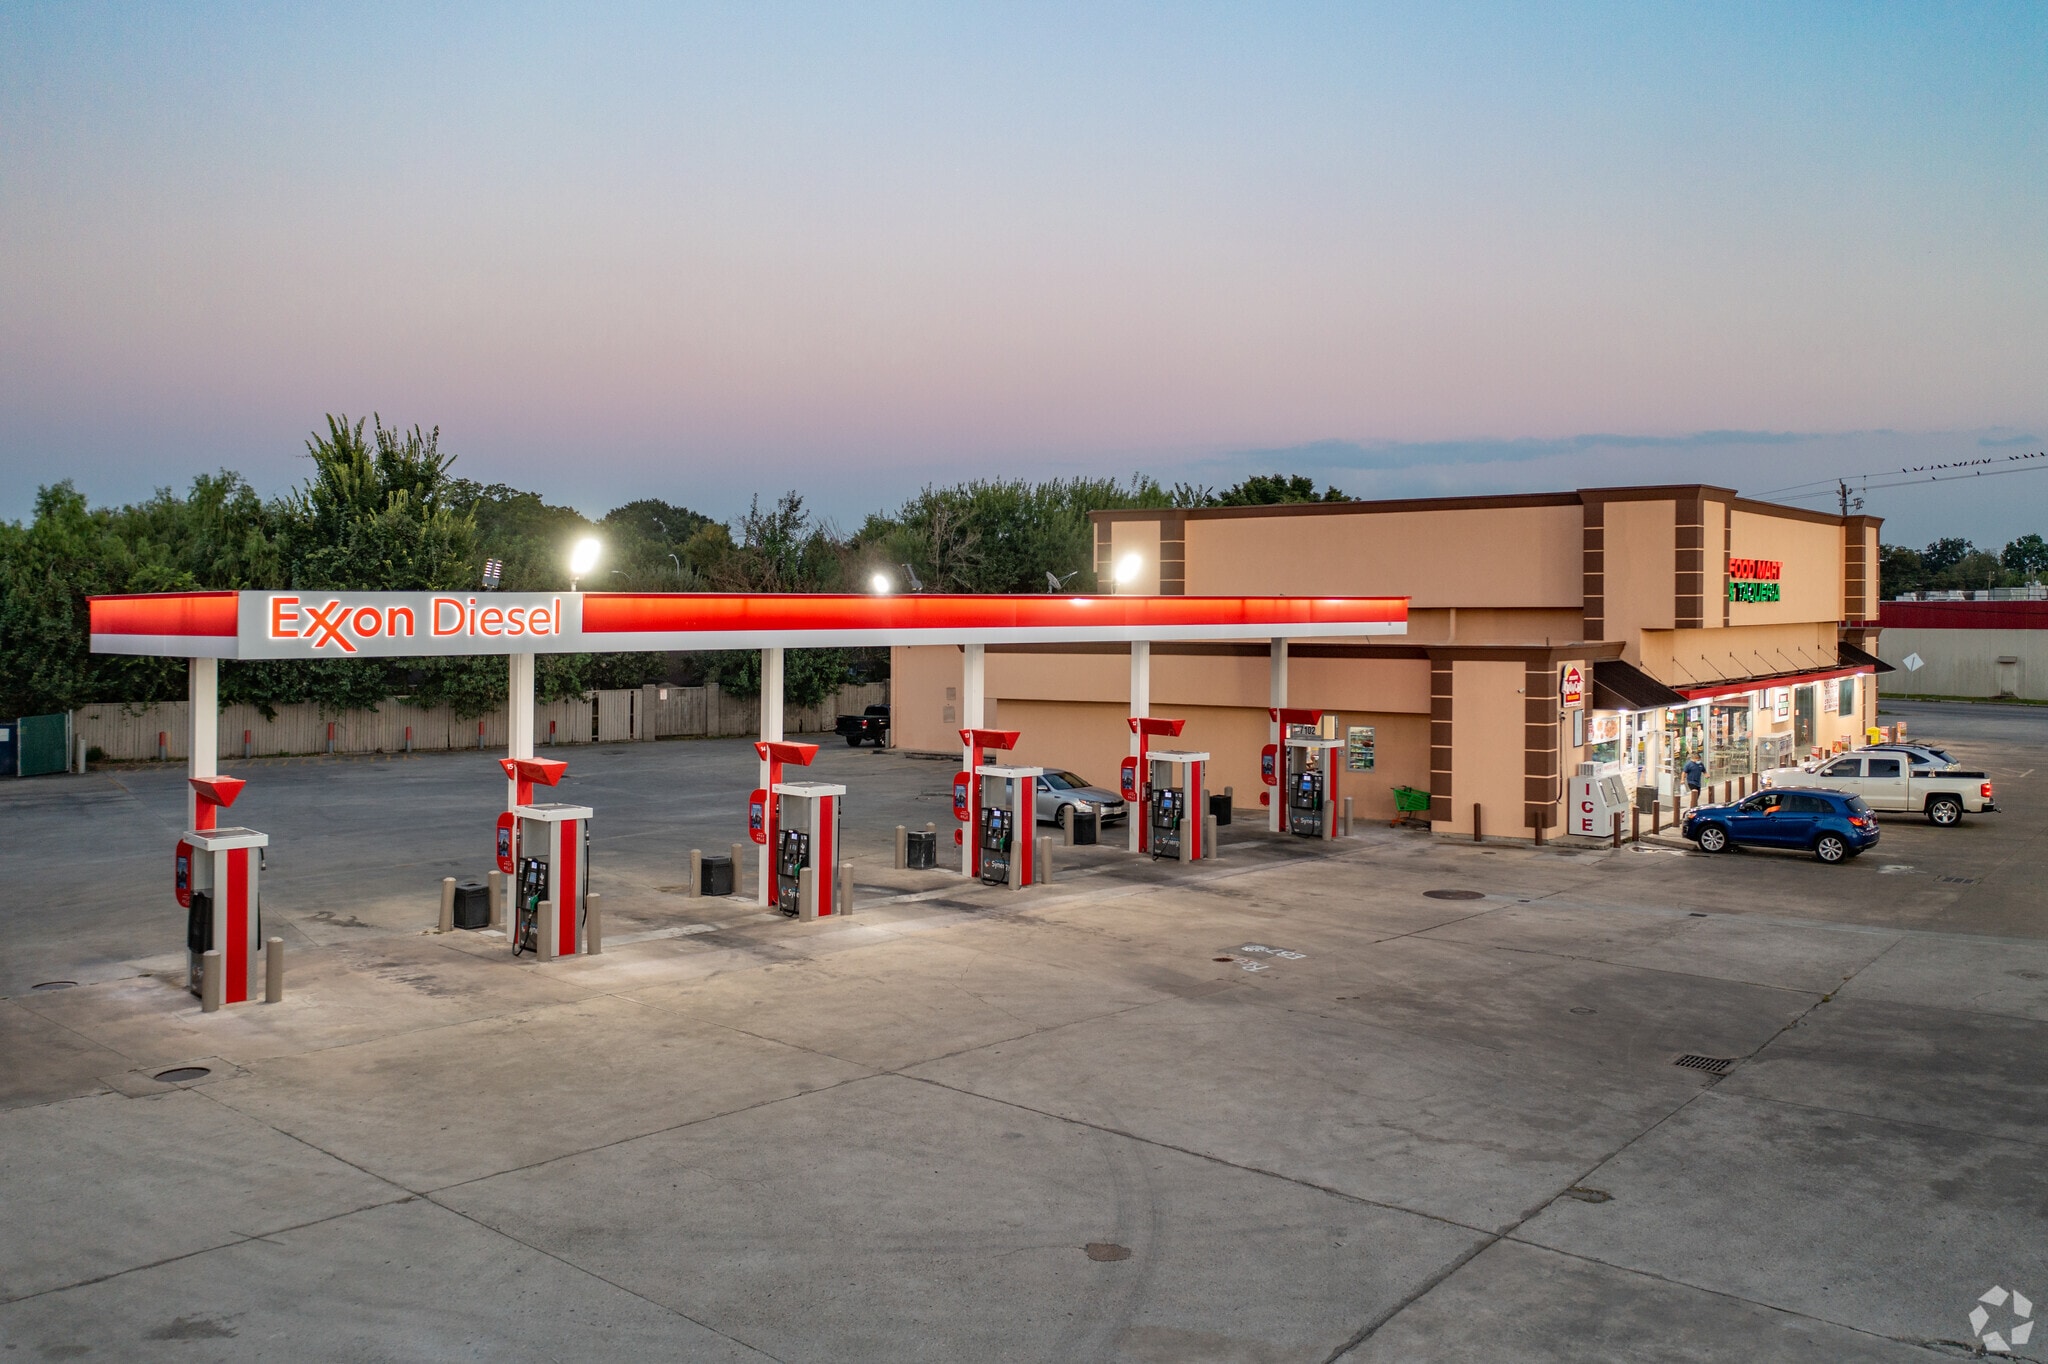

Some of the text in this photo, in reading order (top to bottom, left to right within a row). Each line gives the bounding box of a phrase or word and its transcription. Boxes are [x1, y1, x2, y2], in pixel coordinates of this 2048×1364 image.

[1729, 557, 1783, 580] FOOD MART
[1735, 582, 1780, 603] TAQUERIA
[270, 596, 561, 652] Exxon Diesel
[1299, 725, 1316, 736] 7102
[1581, 782, 1594, 831] ICE
[1609, 810, 1625, 827] IE
